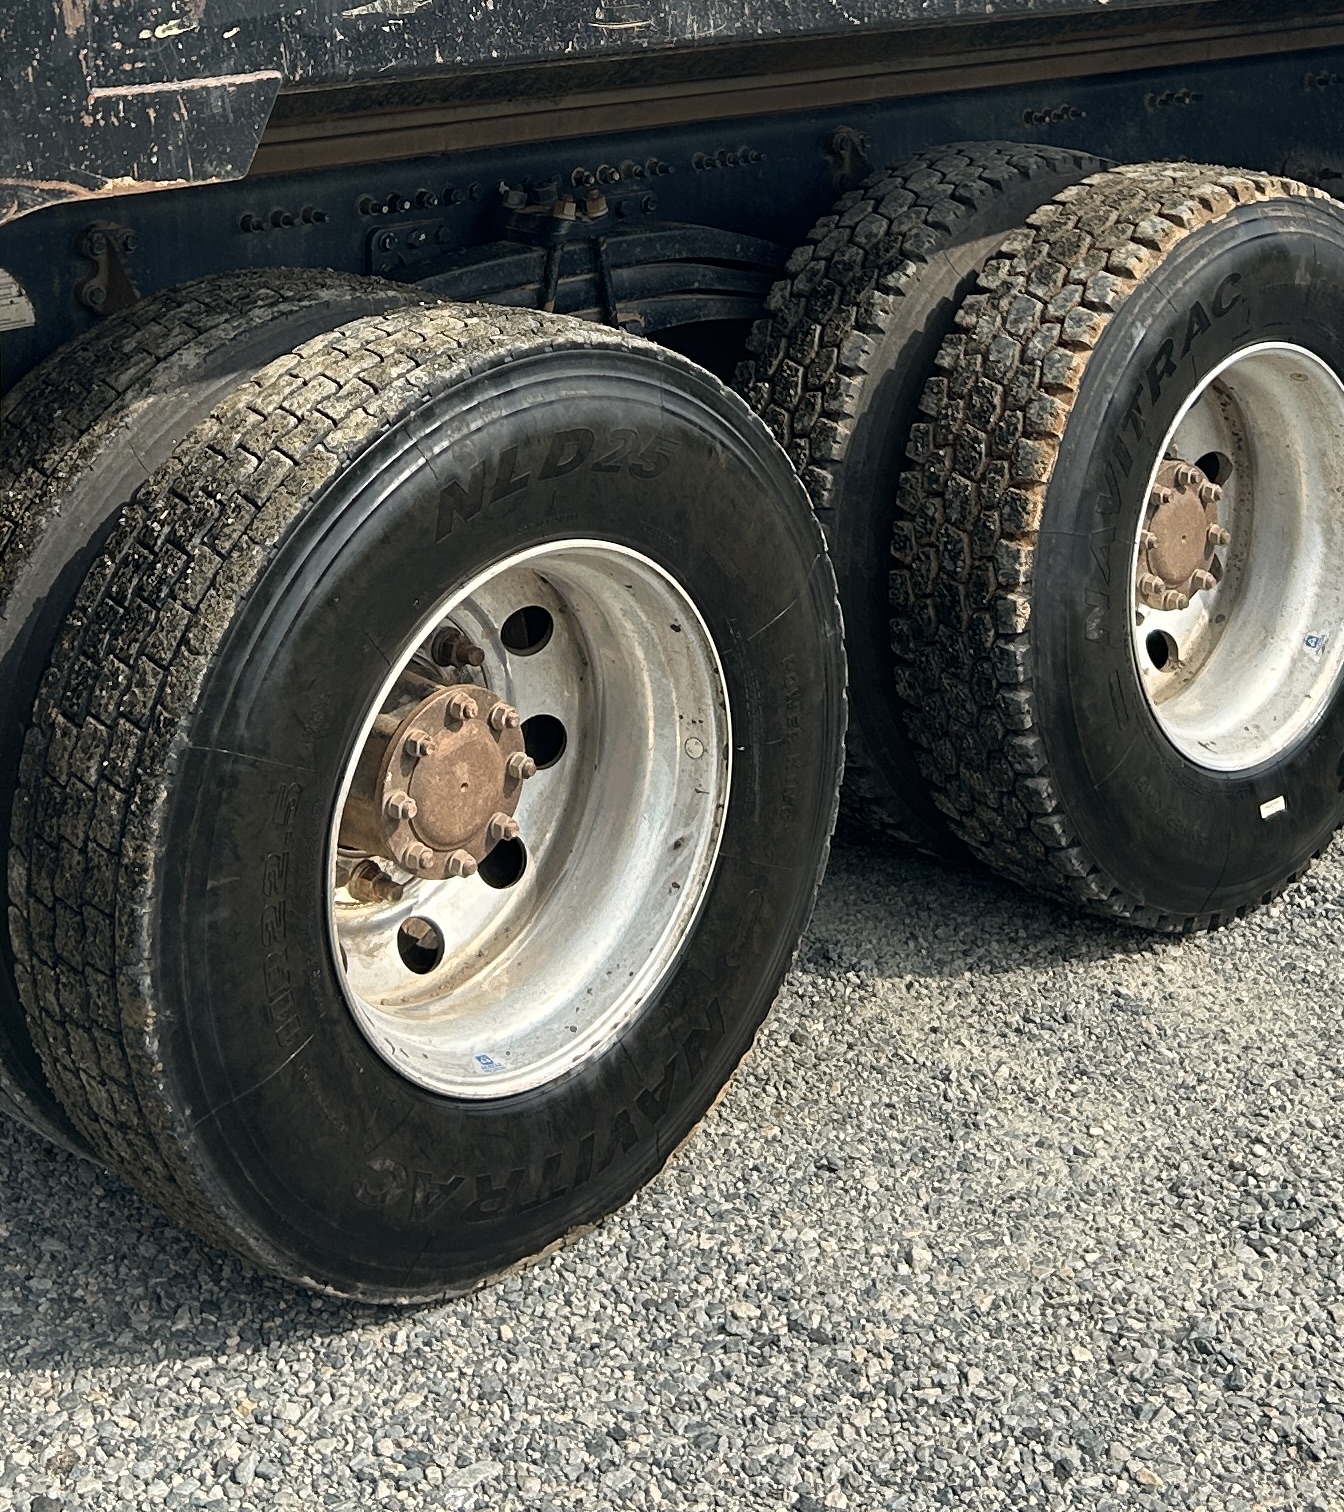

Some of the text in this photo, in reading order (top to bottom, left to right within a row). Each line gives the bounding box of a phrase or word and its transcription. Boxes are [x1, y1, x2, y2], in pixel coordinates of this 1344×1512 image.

[435, 428, 681, 545] NLD25
[1085, 271, 1245, 645] NAVITRAC
[354, 996, 727, 1224] NAVITRAC
